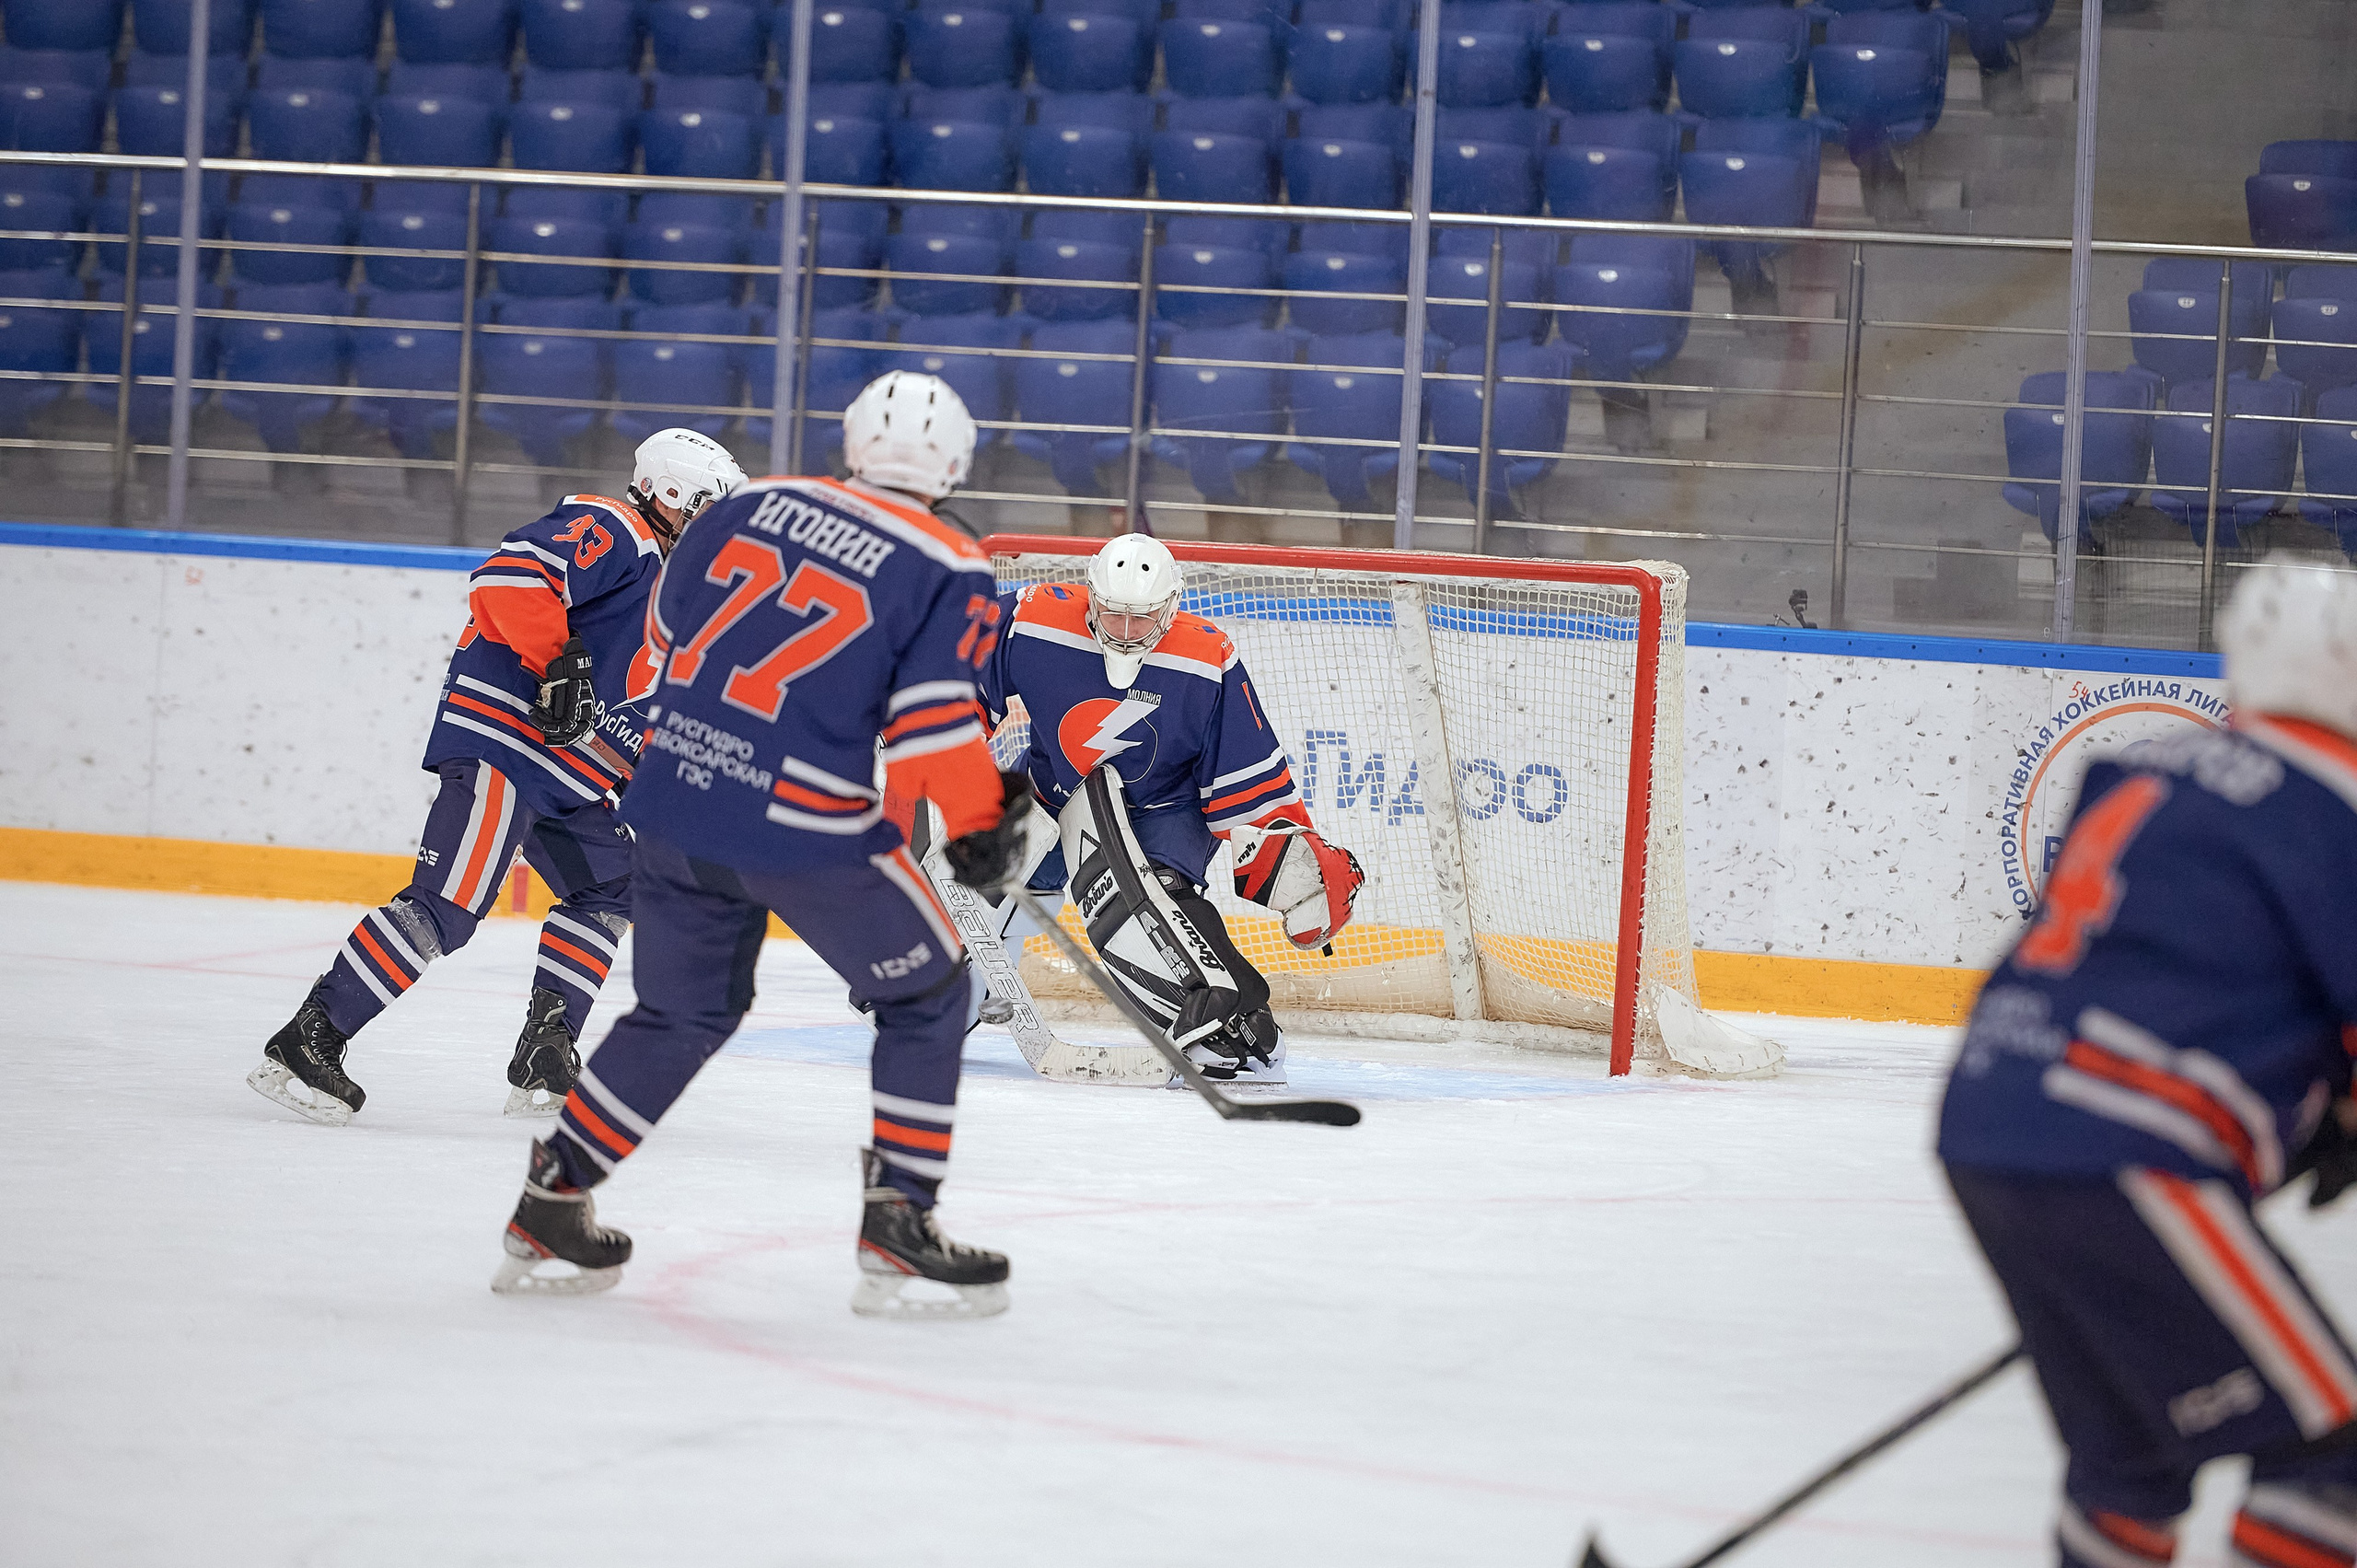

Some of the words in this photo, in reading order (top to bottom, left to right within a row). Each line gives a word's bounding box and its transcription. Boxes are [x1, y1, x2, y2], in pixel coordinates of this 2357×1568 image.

[675, 434, 715, 451] CCM
[748, 490, 896, 579] ИГОНИН
[665, 533, 874, 724] 77
[576, 656, 592, 669] MA
[1126, 688, 1163, 706] МОЛНИЯ
[595, 700, 645, 757] РусГид
[676, 760, 714, 791] ГЭС
[1286, 729, 1569, 826] Гидро
[2001, 726, 2055, 921] КОРПОРАТИВНАЯ
[2051, 679, 2182, 732] ХОККЕЙНАЯ
[1171, 909, 1226, 973] Brian's
[1171, 960, 1191, 981] PAC
